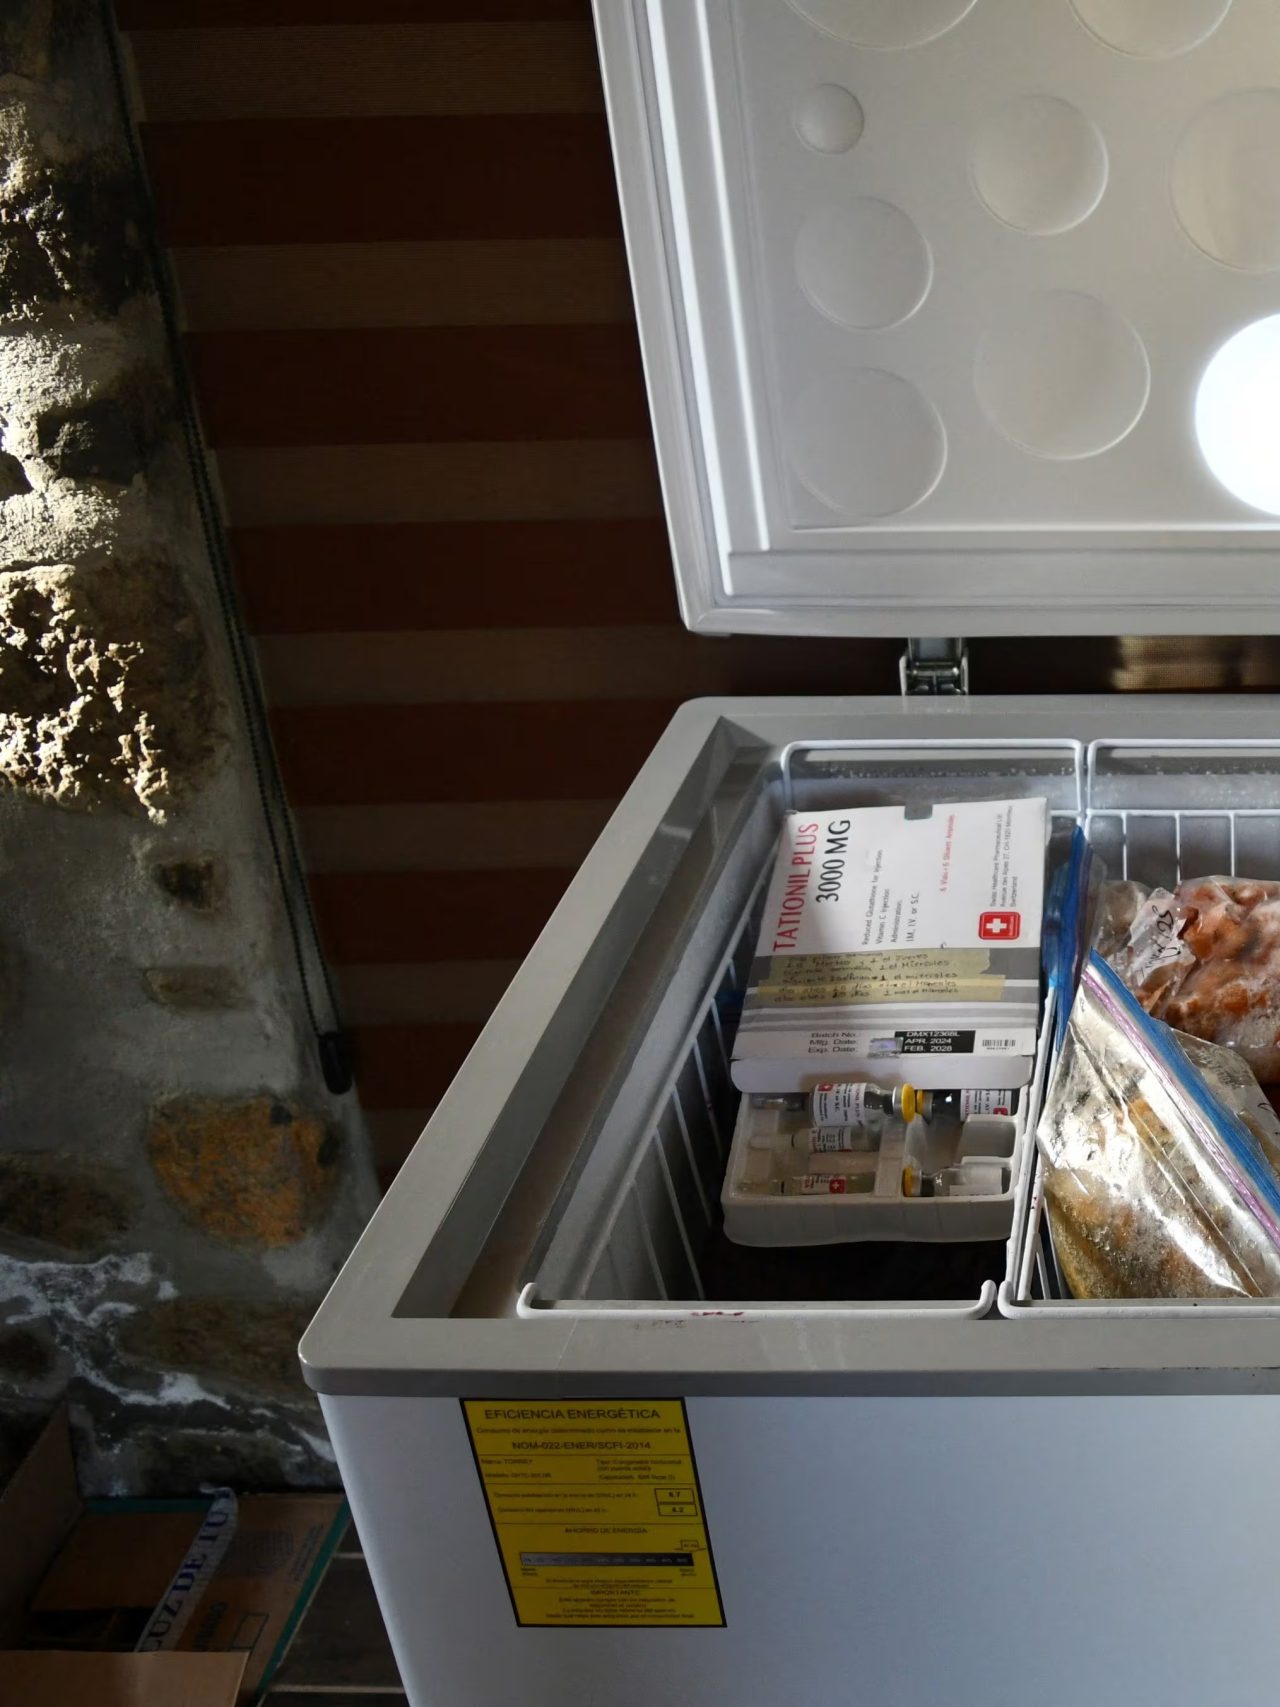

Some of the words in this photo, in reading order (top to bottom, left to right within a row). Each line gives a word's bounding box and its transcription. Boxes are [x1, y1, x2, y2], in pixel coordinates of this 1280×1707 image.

[826, 819, 852, 855] MG
[773, 869, 811, 952] TATIONIL
[792, 823, 819, 866] PLUS
[816, 859, 846, 904] 3000
[862, 919, 872, 945] Reduced
[876, 921, 887, 945] Vitamin
[484, 1409, 565, 1419] EFICIENCIA
[567, 1408, 660, 1419] ENERGÉTICA
